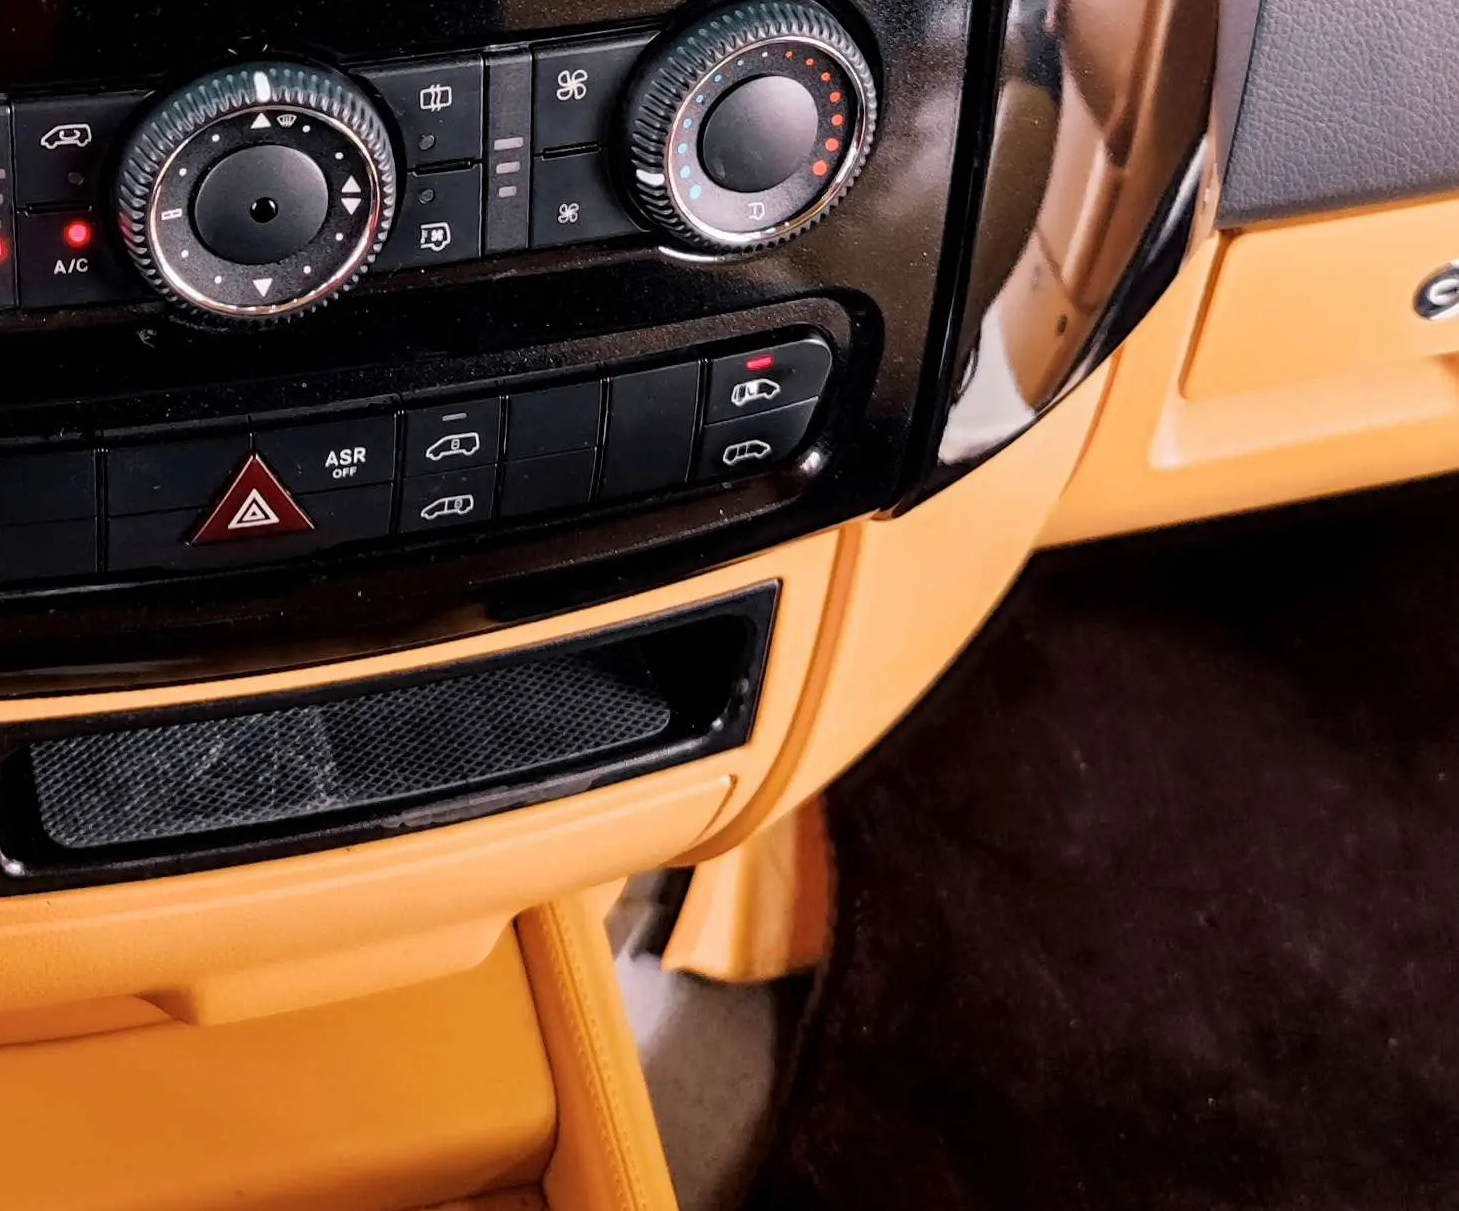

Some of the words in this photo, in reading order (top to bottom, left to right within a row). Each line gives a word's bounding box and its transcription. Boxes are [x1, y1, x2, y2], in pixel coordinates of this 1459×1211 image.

[54, 259, 88, 275] A/C
[325, 447, 366, 467] ASR
[332, 466, 357, 479] OFF
